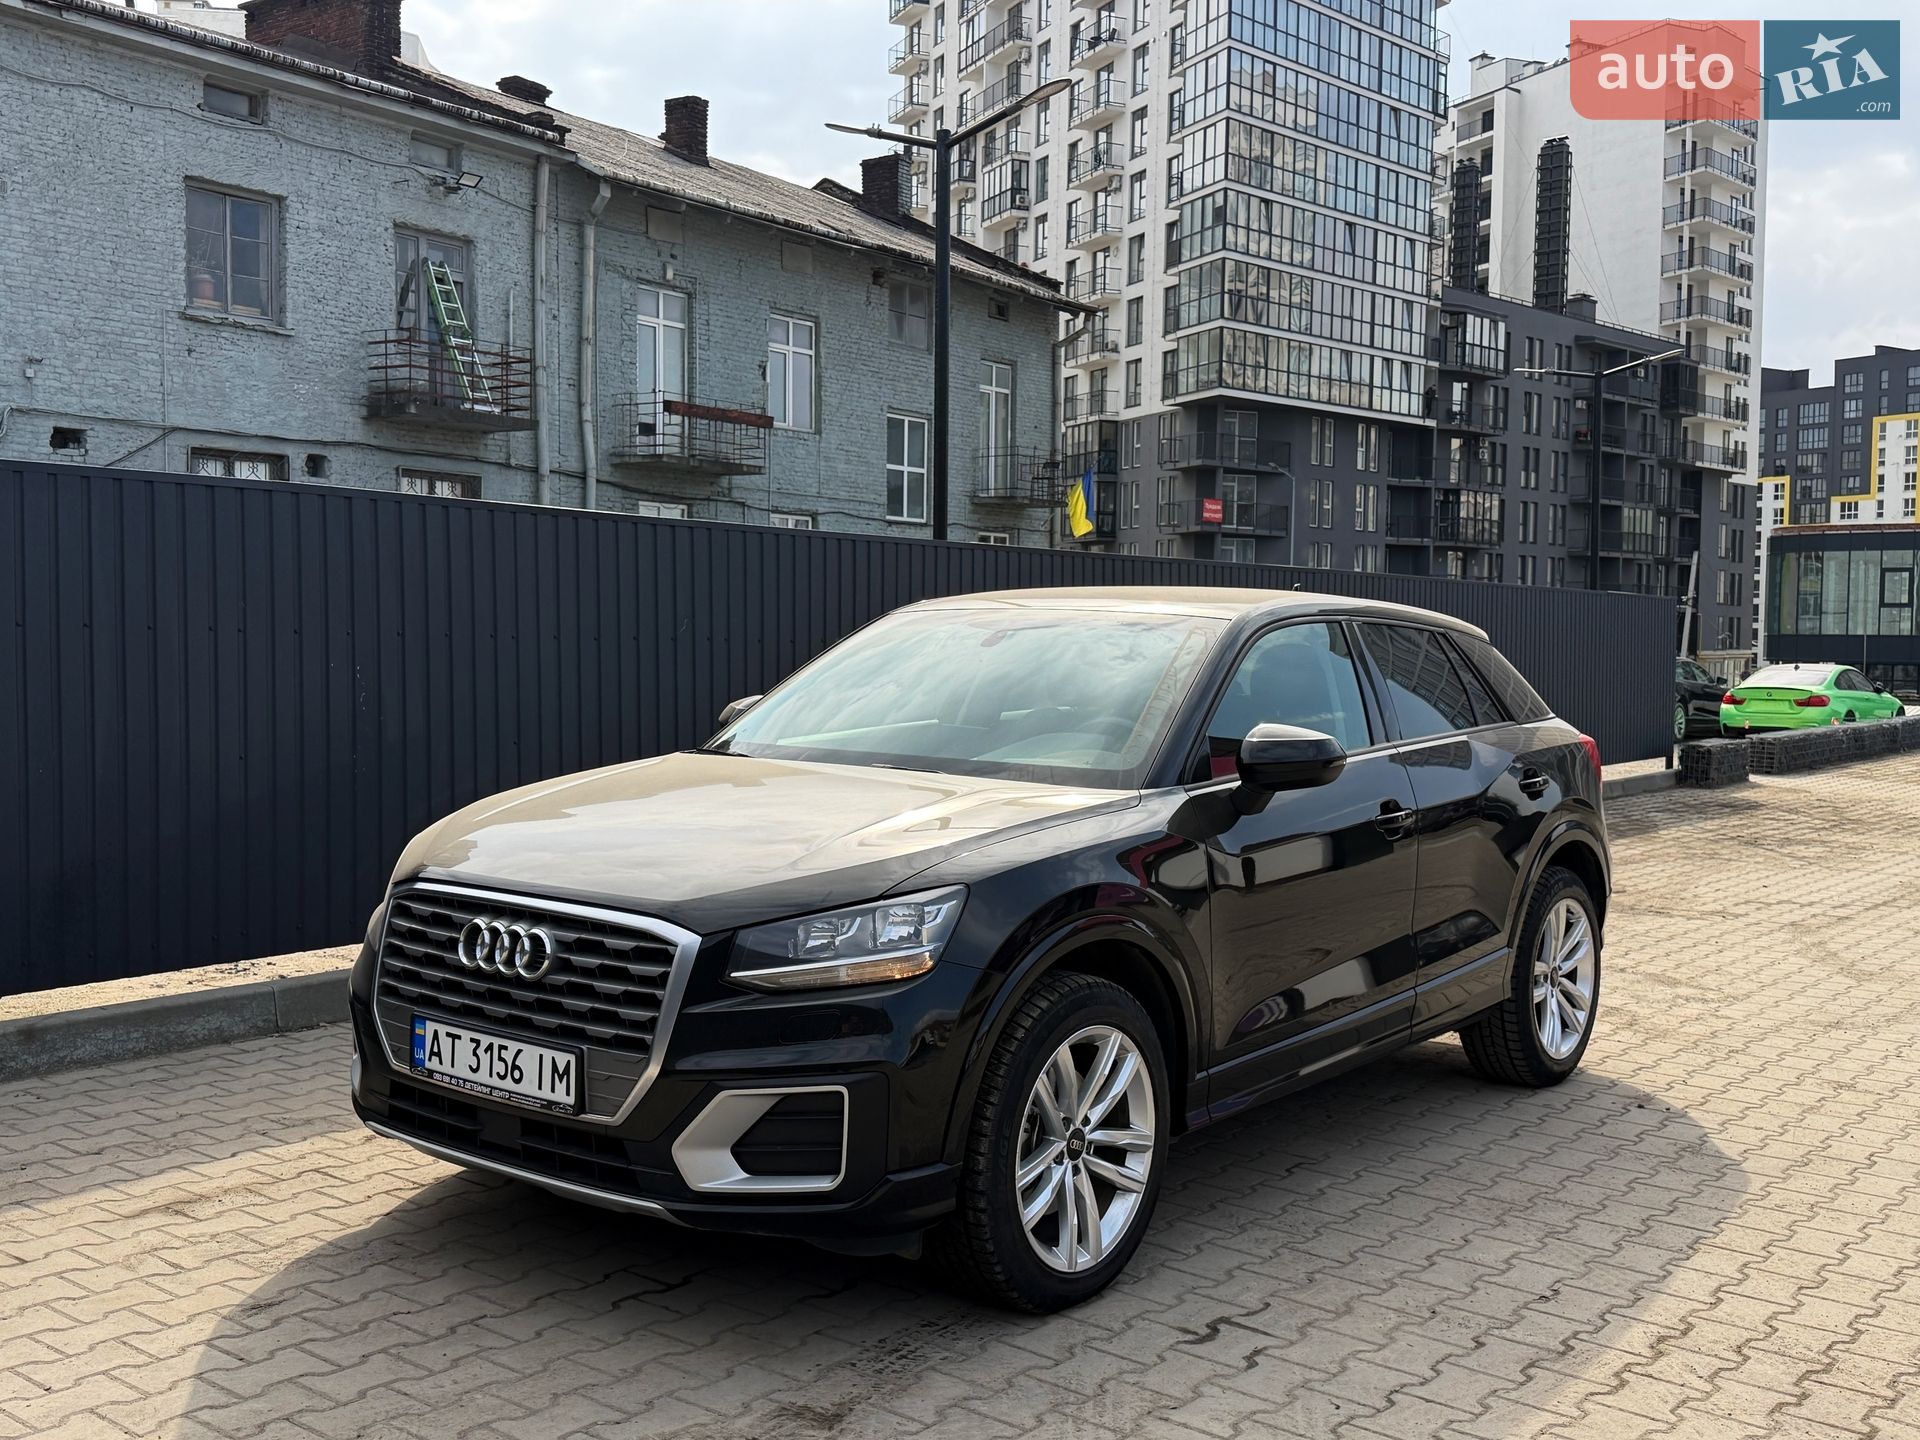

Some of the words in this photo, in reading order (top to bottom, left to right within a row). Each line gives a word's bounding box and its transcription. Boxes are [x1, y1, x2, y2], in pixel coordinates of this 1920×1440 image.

[414, 1047, 425, 1061] UA
[428, 1029, 462, 1069] AT
[468, 1037, 524, 1085] 3156
[537, 1053, 571, 1097] IM
